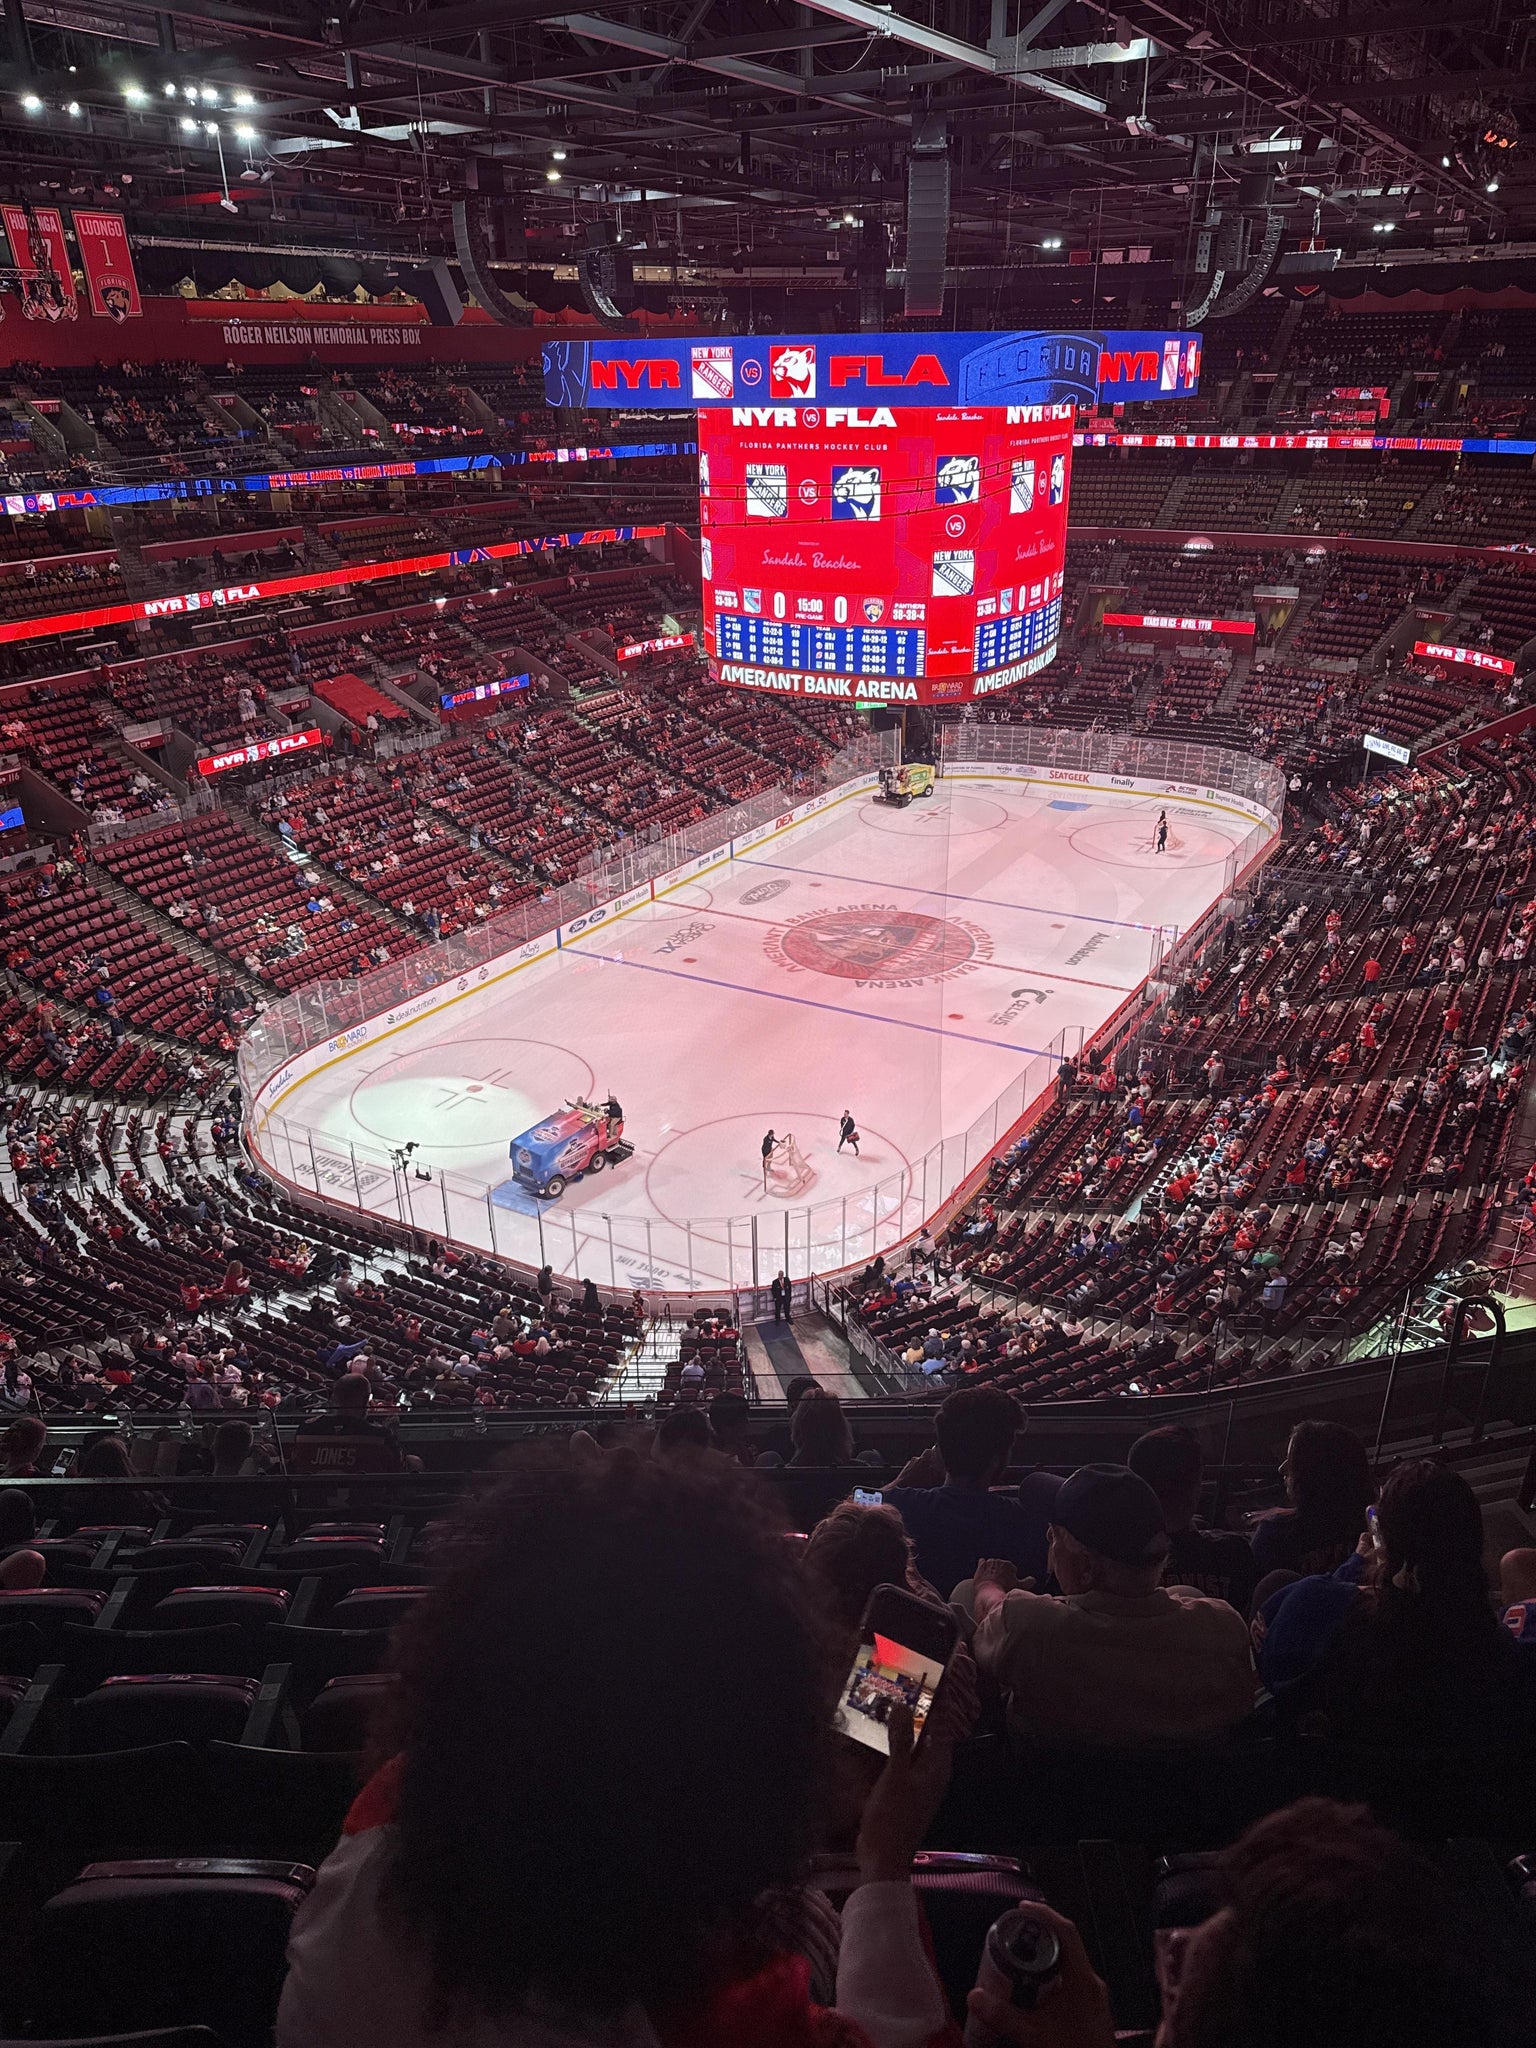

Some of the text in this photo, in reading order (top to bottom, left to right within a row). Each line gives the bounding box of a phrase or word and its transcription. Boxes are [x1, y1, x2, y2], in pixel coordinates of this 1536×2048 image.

[9, 213, 58, 232] HUNGA
[80, 218, 122, 237] LUONGO
[101, 239, 113, 266] 1
[223, 326, 421, 344] ROGER NEILSON MEMORIAL PRESS BOX
[692, 347, 732, 358] NEW YORK
[591, 359, 680, 389] NYR
[745, 367, 761, 377] VS
[829, 354, 950, 387] FLA
[978, 344, 1091, 388] FLORIDA
[1097, 351, 1159, 384] NYR
[697, 362, 732, 397] RANGERS
[732, 408, 796, 427] NYR
[826, 408, 897, 427] FLA
[1007, 405, 1071, 424] NYR FLA
[776, 442, 820, 450] PANTHERS
[824, 443, 860, 451] HOCKEY
[1385, 437, 1417, 449] FLORIDA
[1419, 438, 1463, 450] PANTHERS
[354, 465, 382, 480] FLORIDA
[746, 464, 786, 476] NEW YORK
[57, 493, 96, 506] FLA
[752, 478, 786, 516] RANGERS
[803, 487, 816, 497] VS
[934, 550, 974, 561] NEW YORK
[939, 564, 972, 593] RANGERS
[144, 586, 260, 615] NYR FLA
[774, 592, 785, 618] 0
[797, 598, 823, 613] 15:00
[834, 596, 847, 623] 0
[893, 609, 925, 621] 38-38-4
[1181, 619, 1196, 629] APRIL
[625, 638, 683, 656] NYR FLA
[1426, 645, 1503, 669] NYR FLA
[721, 664, 918, 700] AMERANT BANK ARENA
[973, 661, 1028, 695] AMERANT
[1028, 653, 1045, 676] BANK
[452, 691, 475, 704] NYR
[213, 736, 308, 769] NYR FLA
[1049, 770, 1089, 783] SEATGEEK
[1110, 777, 1134, 788] finally
[775, 812, 794, 830] DEX
[785, 904, 898, 924] BANK ARENA
[945, 916, 995, 961] AMERANT
[762, 927, 806, 973] AMERANT
[928, 963, 980, 984] BANK
[855, 979, 924, 989] ARENA
[993, 999, 1030, 1026] CELSIUS
[328, 1026, 367, 1052] BROWARD
[615, 1255, 637, 1268] LINE
[311, 1448, 357, 1465] JONES
